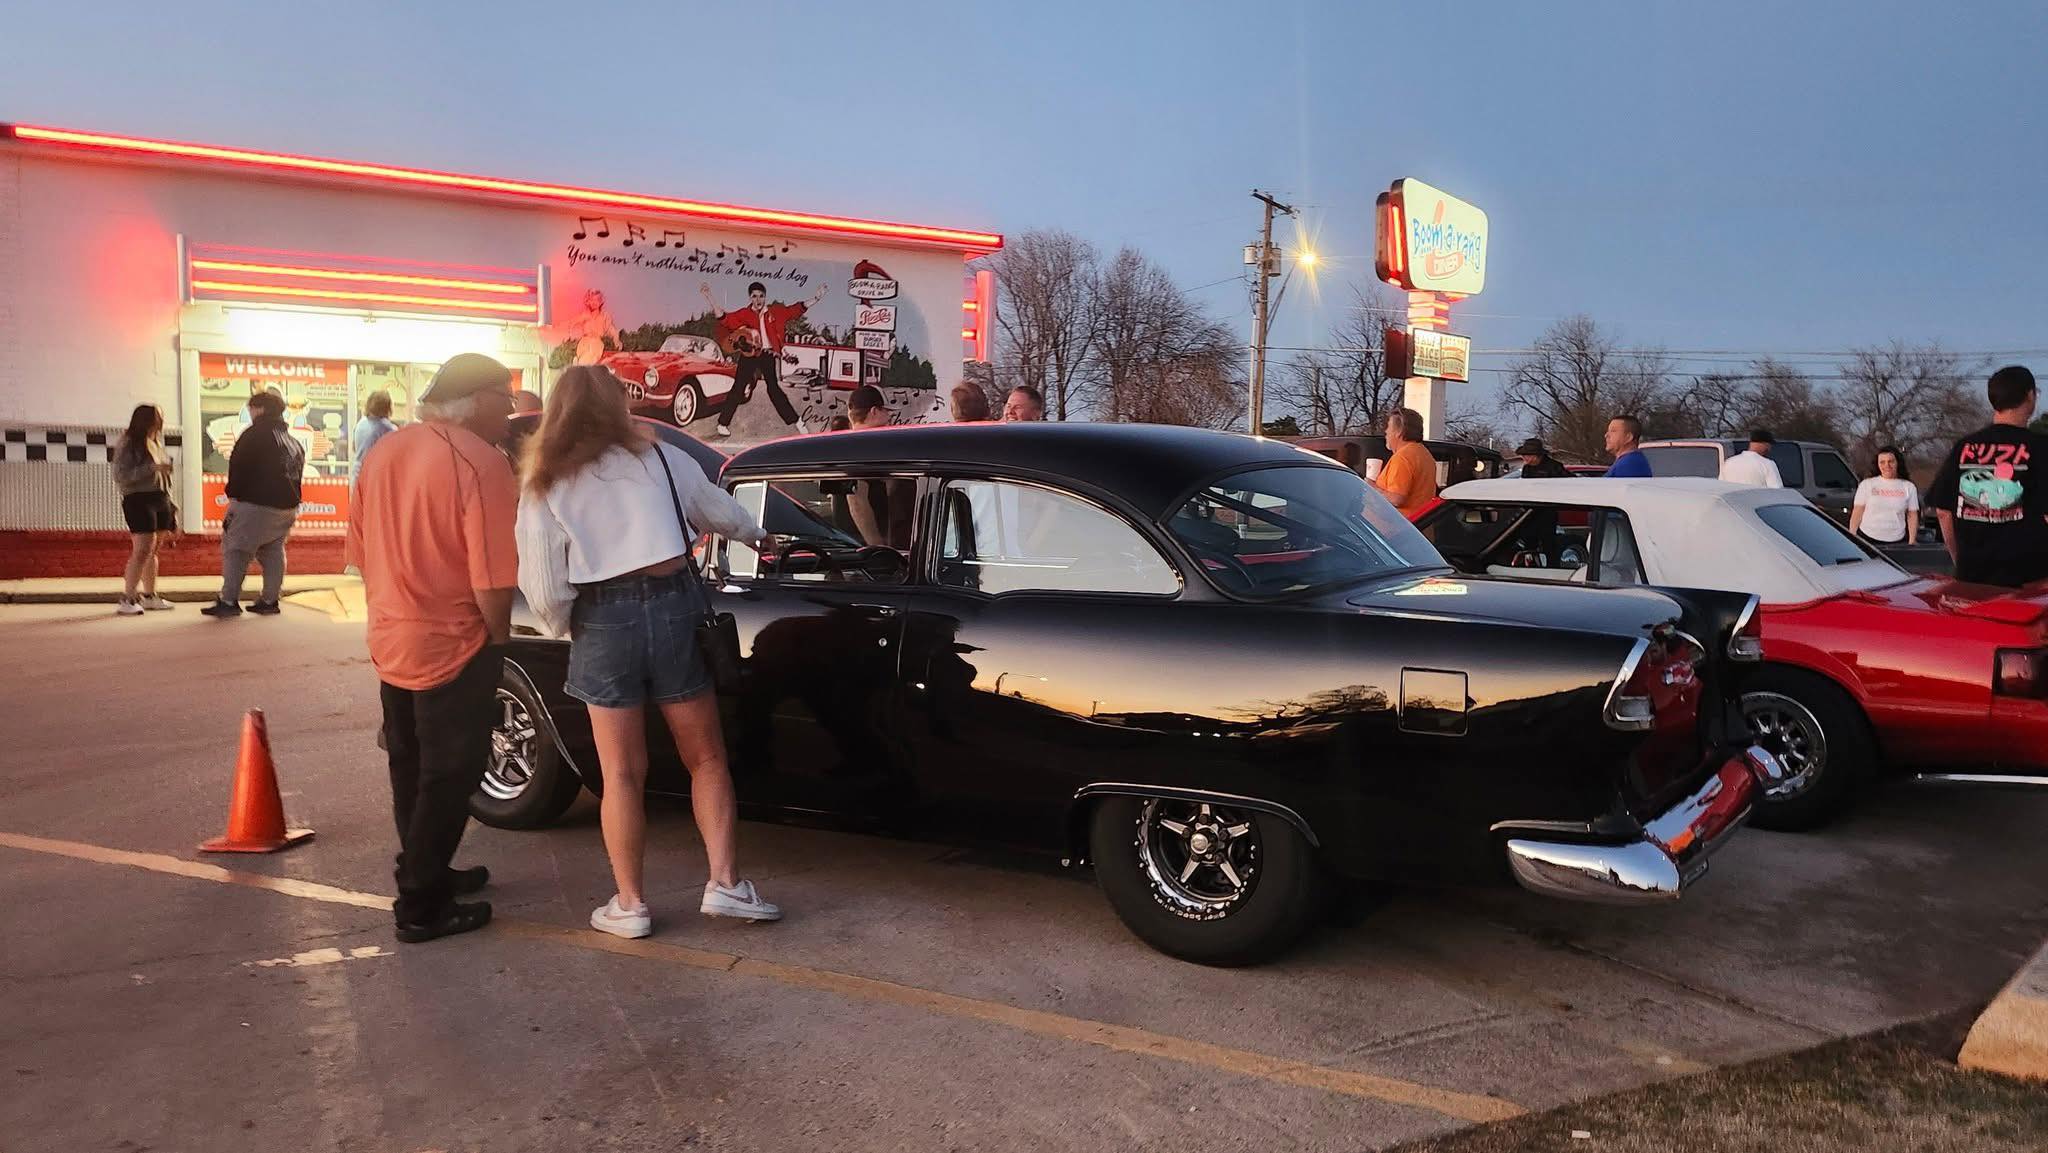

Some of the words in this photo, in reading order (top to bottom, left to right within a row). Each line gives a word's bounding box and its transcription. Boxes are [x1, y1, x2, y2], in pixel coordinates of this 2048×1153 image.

[567, 244, 597, 267] You
[601, 251, 643, 265] ain't
[645, 256, 695, 271] nothin
[700, 259, 722, 273] but
[725, 267, 734, 275] a
[738, 263, 783, 279] hound
[786, 267, 809, 287] dog
[224, 358, 326, 378] WELCOME
[1960, 443, 2031, 465] ドリフト
